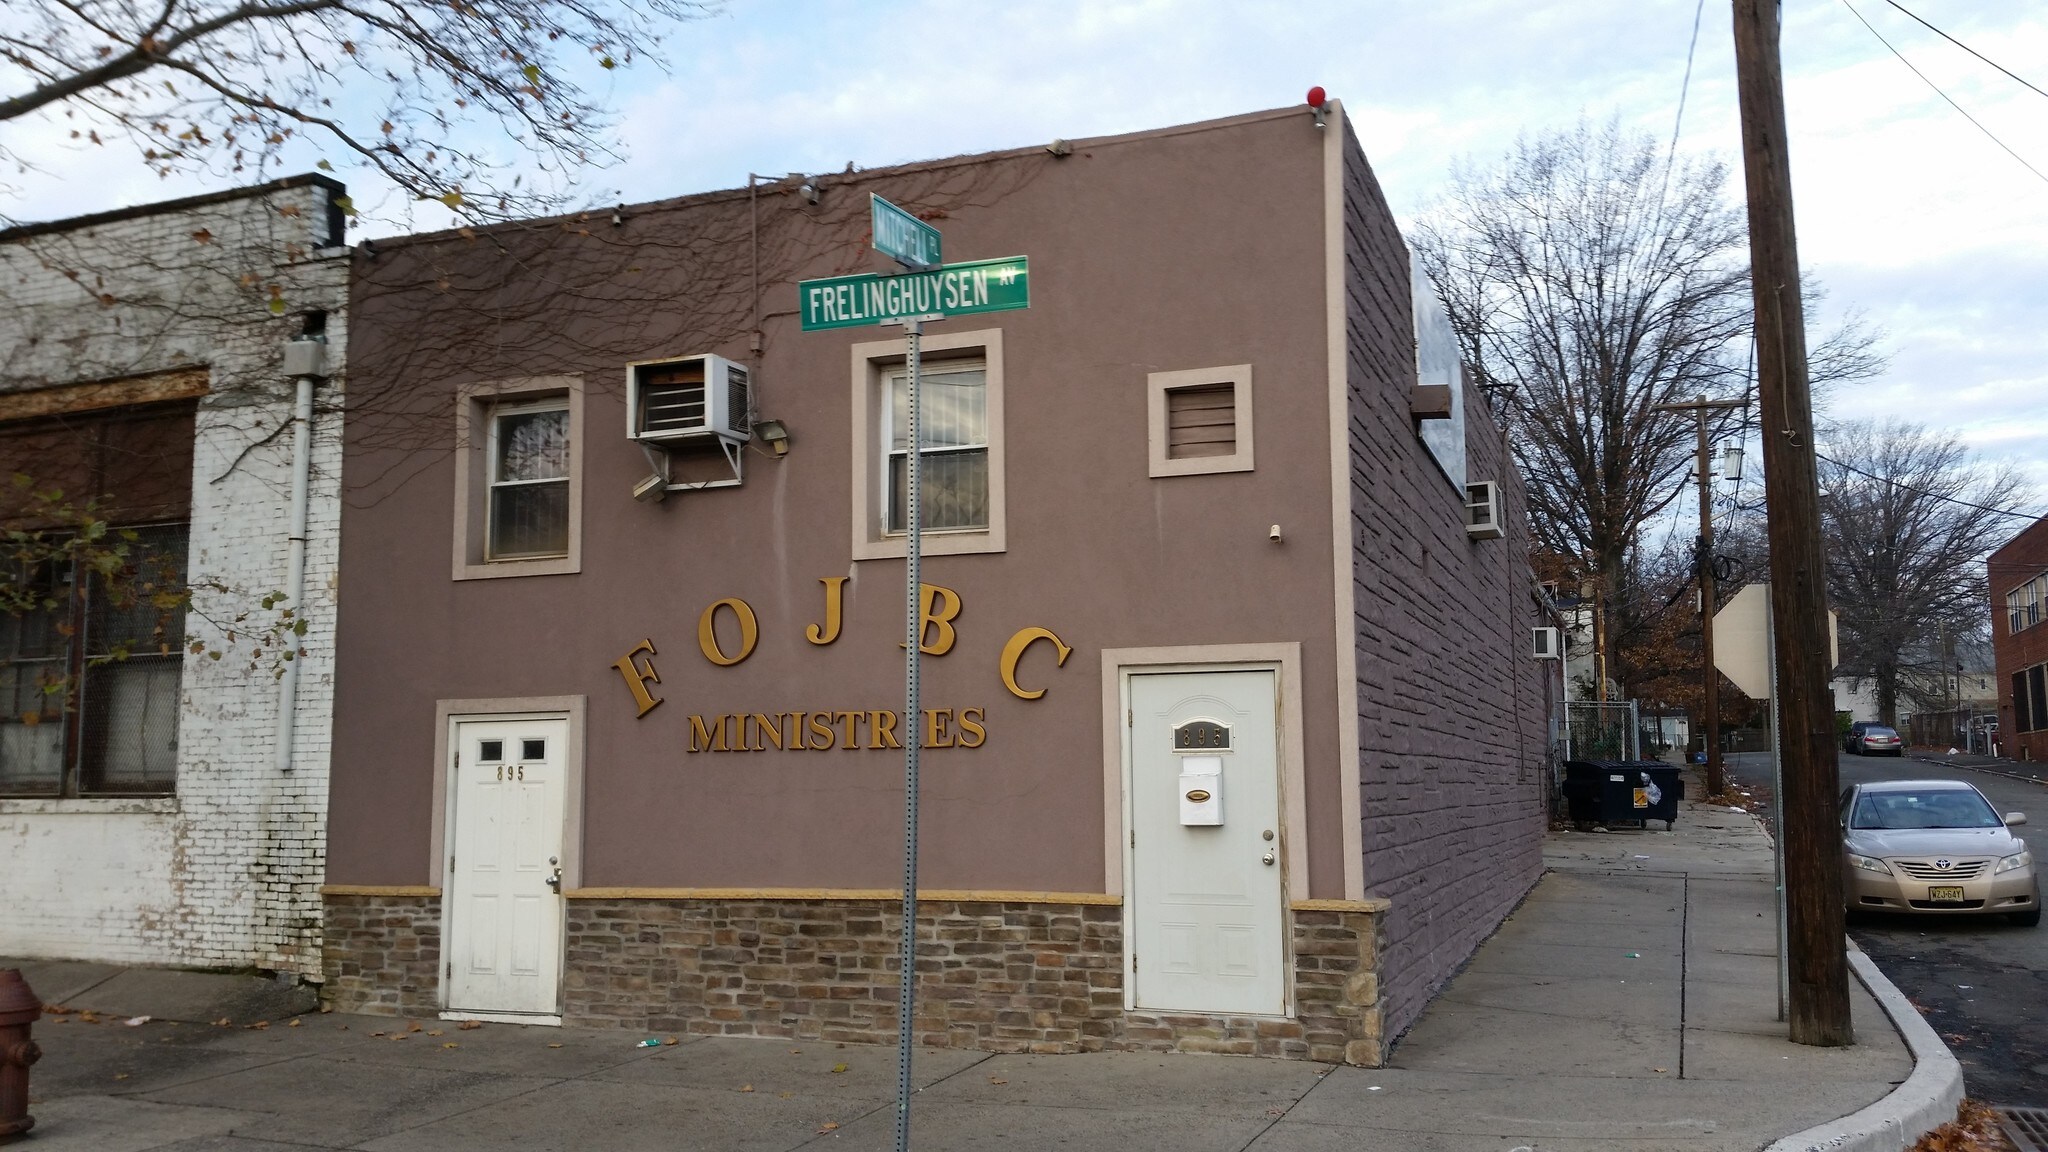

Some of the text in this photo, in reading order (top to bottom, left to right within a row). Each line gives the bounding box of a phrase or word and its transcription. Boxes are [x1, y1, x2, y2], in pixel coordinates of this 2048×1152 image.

[809, 266, 1017, 324] FRELINGHUYSEN AV
[687, 707, 987, 753] MINISTRES
[497, 765, 525, 781] 895
